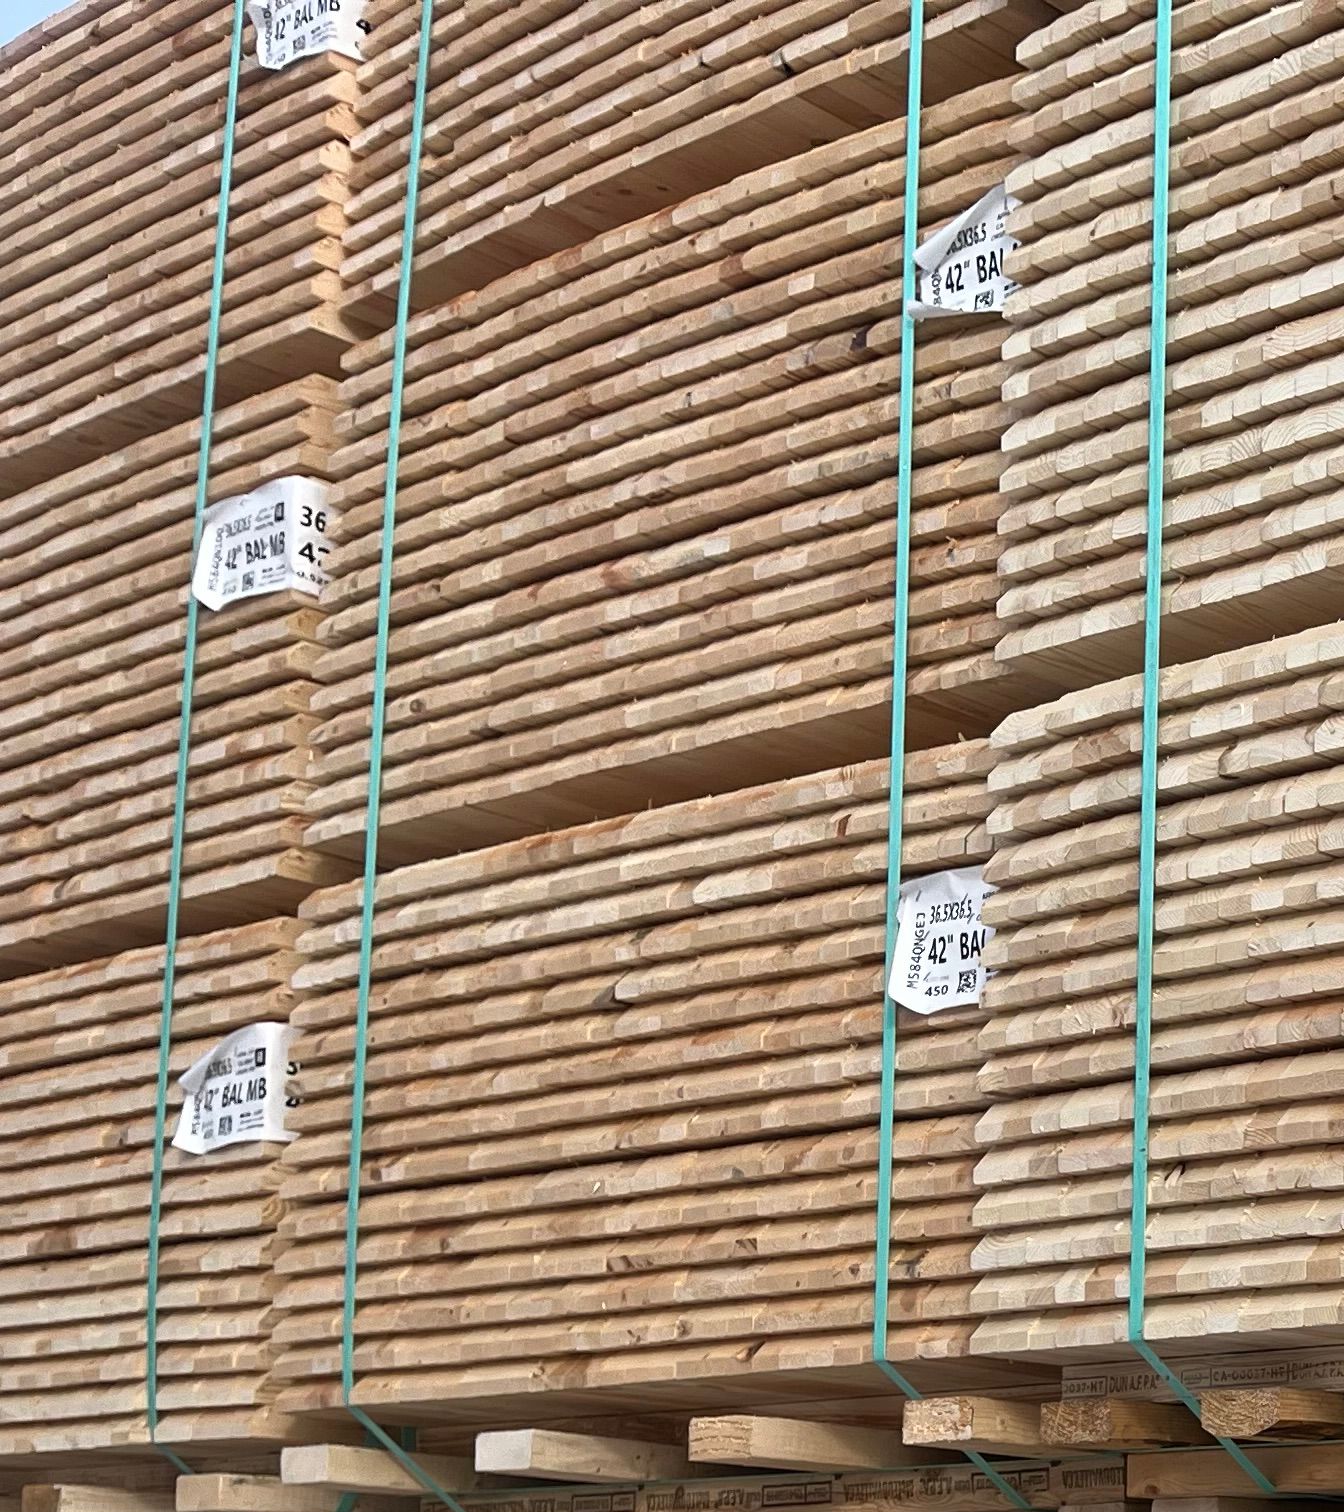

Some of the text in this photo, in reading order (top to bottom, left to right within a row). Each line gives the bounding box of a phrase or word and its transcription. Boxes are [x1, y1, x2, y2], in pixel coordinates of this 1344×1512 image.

[294, 5, 313, 30] BAL
[945, 260, 970, 294] 42"
[245, 538, 267, 564] BAL
[930, 900, 972, 924] 36.5X36.5
[928, 934, 954, 965] 42"
[925, 985, 949, 997] 450
[222, 1082, 243, 1108] BAL
[246, 1077, 266, 1101] MB
